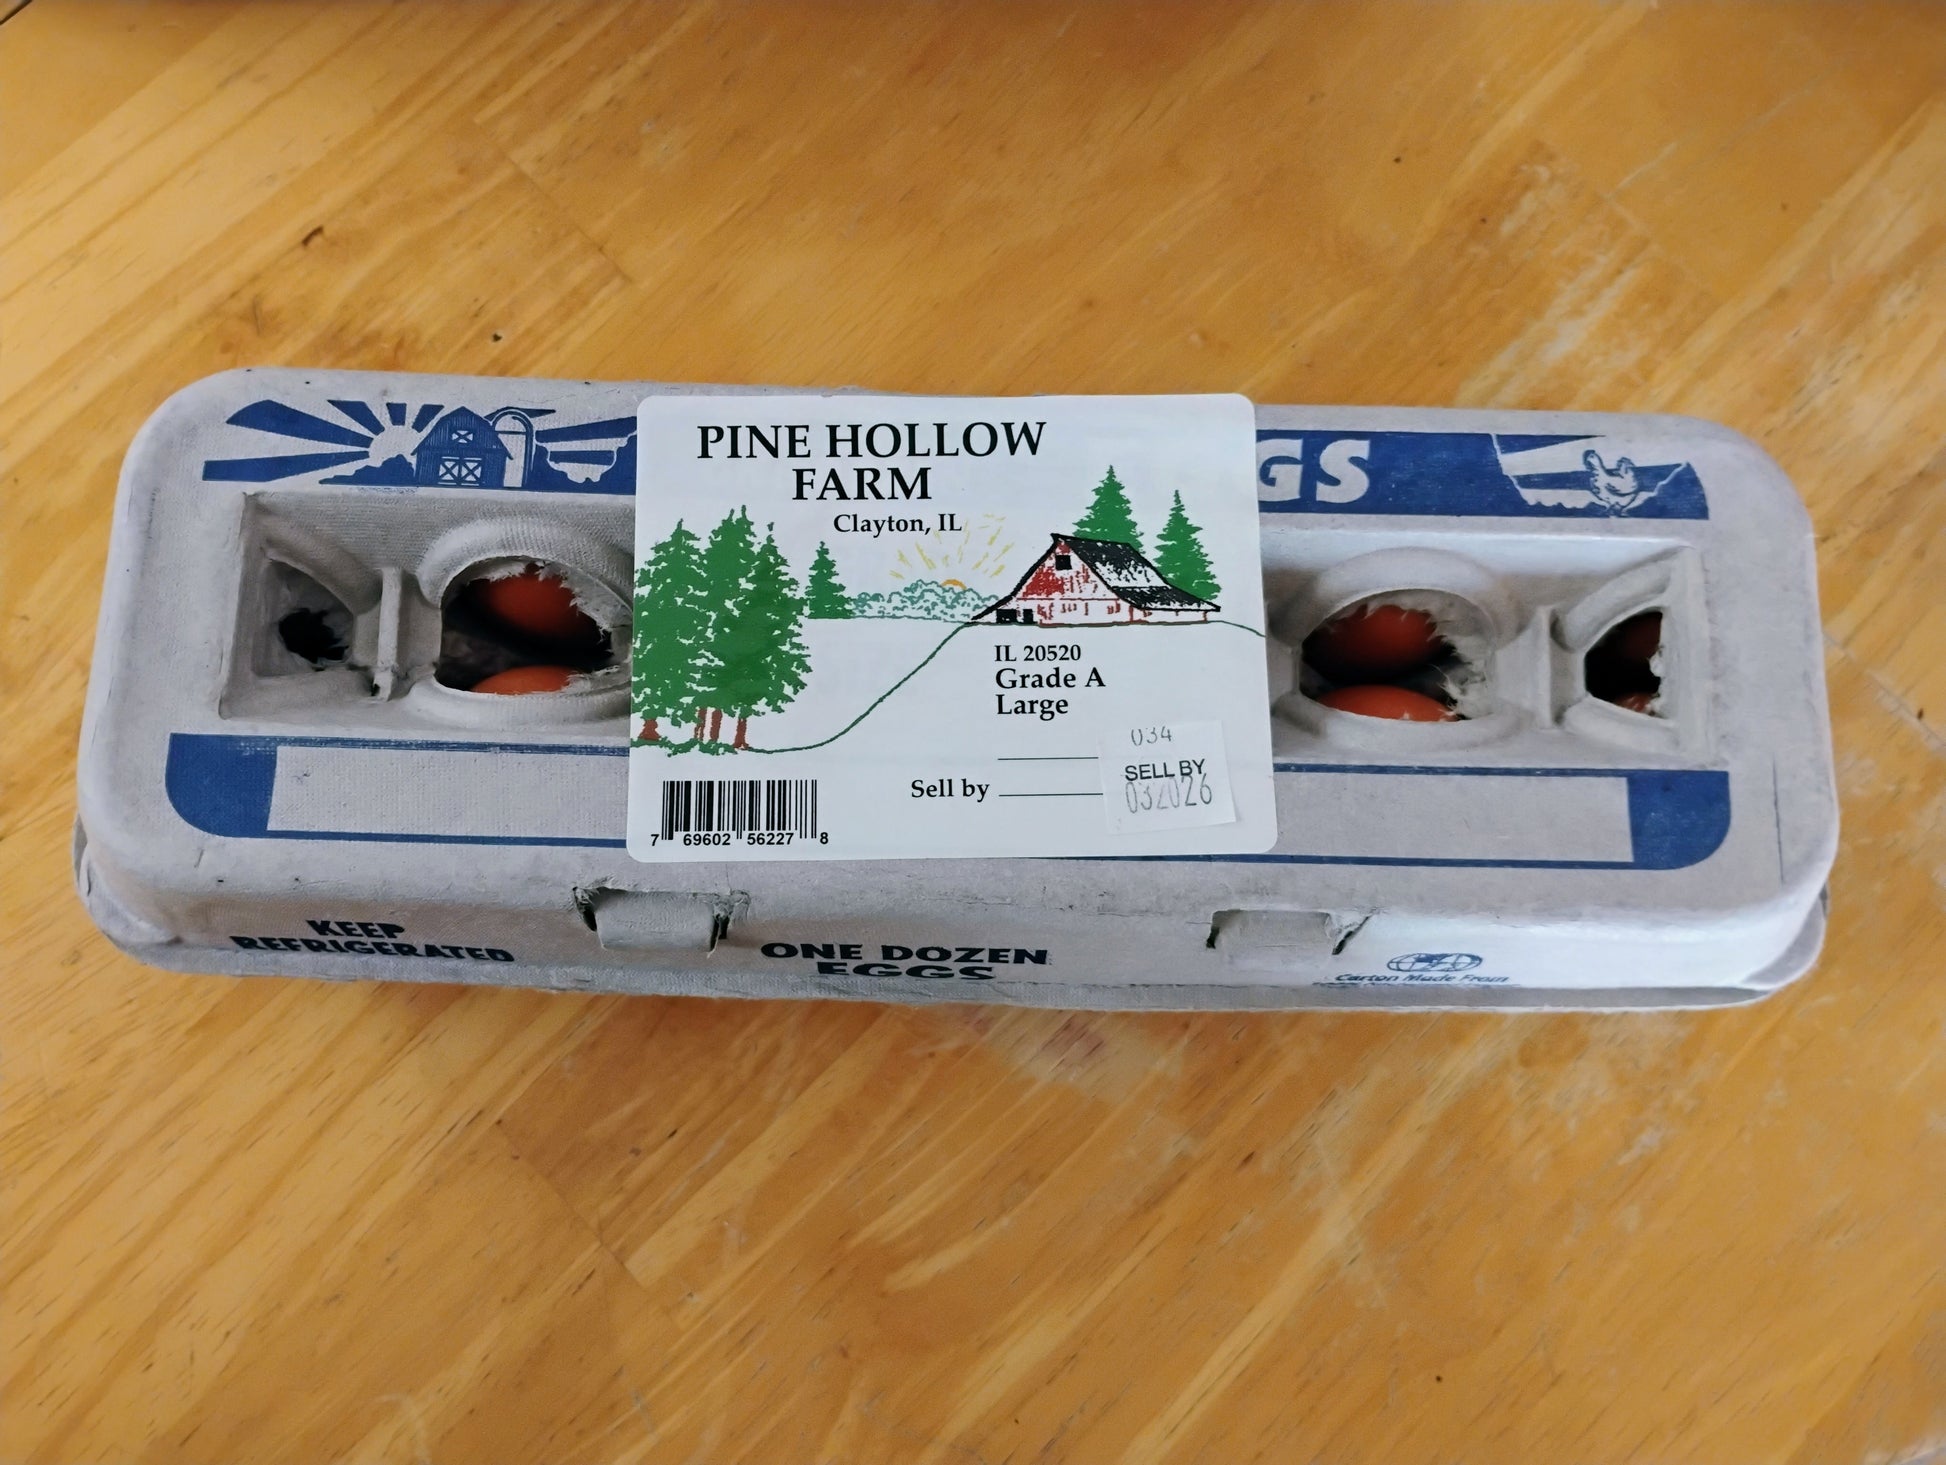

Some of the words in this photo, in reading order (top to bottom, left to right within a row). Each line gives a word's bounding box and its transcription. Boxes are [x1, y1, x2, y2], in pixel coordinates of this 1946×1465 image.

[697, 425, 811, 458] PINE
[826, 421, 1047, 457] HOLLOW
[792, 468, 932, 501] FARM
[833, 514, 931, 538] Clayton,
[938, 514, 962, 532] IL
[995, 645, 1016, 662] IL
[1024, 644, 1082, 662] 20520
[996, 667, 1076, 689] Grade
[1085, 667, 1106, 688] A
[996, 694, 1069, 721] Large
[1131, 726, 1172, 746] 034
[1125, 762, 1175, 782] SELL
[1180, 759, 1206, 777] BY
[911, 778, 955, 799] Sell
[961, 778, 990, 803] by
[651, 834, 660, 846] 7
[683, 833, 731, 846] 69602
[747, 833, 794, 846] 56227
[820, 832, 829, 845] 8
[306, 919, 405, 939] KEEP
[230, 935, 514, 962] REFRIGERATED
[761, 943, 863, 960] ONE
[882, 945, 1048, 965] DOZEN
[817, 961, 997, 980] EGGS
[1335, 973, 1400, 983] Carton
[1403, 973, 1456, 983] Made
[1461, 974, 1511, 984] From
